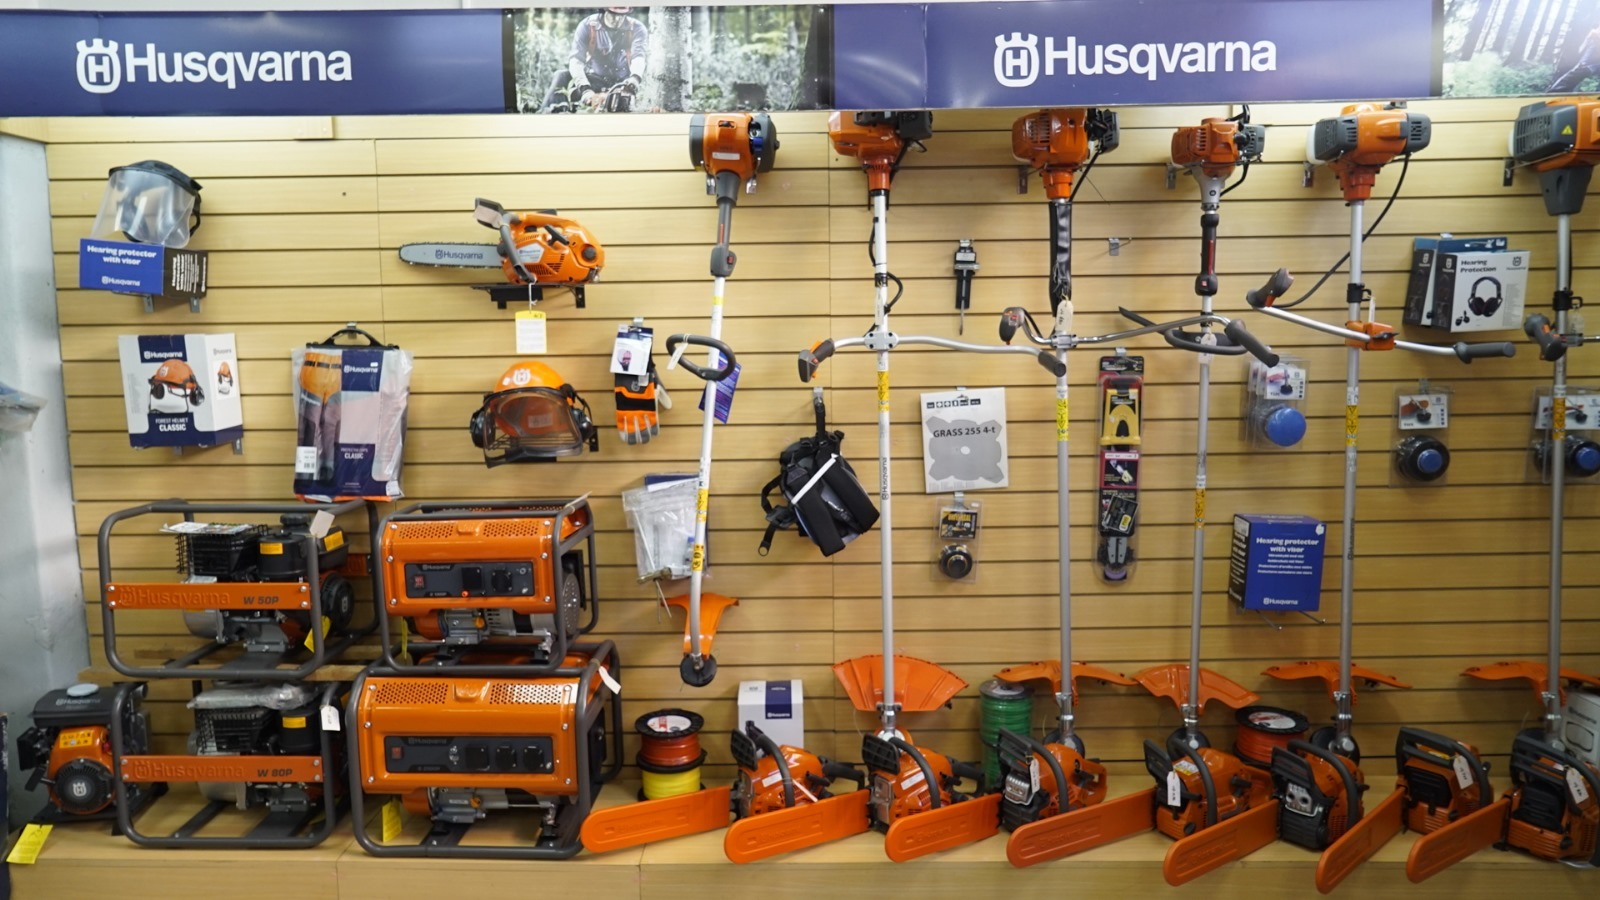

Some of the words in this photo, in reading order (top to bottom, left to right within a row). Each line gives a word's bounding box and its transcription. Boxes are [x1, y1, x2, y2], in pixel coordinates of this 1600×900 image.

[1045, 36, 1277, 81] Husqvarna
[125, 43, 352, 89] Husqvarna
[87, 245, 118, 255] Hearing
[118, 249, 157, 258] protector
[443, 251, 484, 260] Husqvarna
[122, 257, 141, 266] visor
[108, 276, 140, 286] Husqvarna
[159, 424, 187, 432] CLASSIC
[933, 428, 963, 438] GRASS
[965, 427, 981, 436] 255
[983, 426, 996, 434] 4-t
[1256, 538, 1283, 546] Hearing
[138, 589, 231, 606] Husqvarna
[243, 596, 255, 605] W
[258, 595, 279, 605] 50P
[151, 764, 244, 778] Husqvarna
[257, 769, 270, 777] W
[271, 768, 293, 777] 80P
